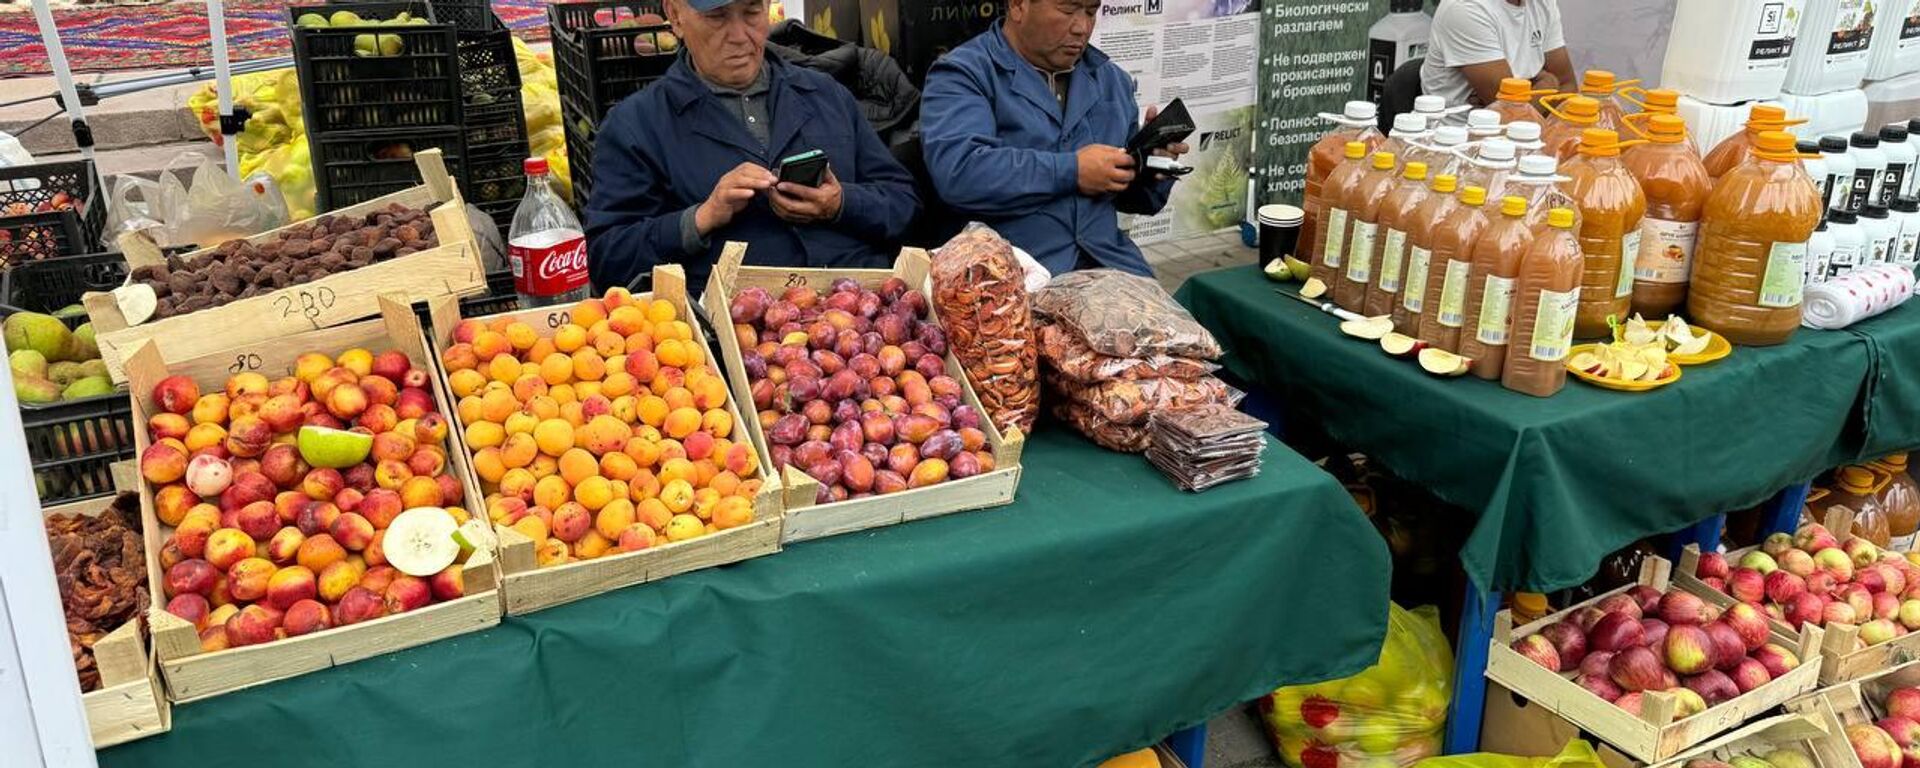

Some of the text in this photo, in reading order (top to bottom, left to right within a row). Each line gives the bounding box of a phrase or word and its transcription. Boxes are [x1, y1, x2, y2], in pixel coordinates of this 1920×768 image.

[1102, 4, 1142, 16] Реликт
[1275, 2, 1369, 18] Биологически
[1275, 20, 1344, 37] разлагаем
[1273, 50, 1366, 67] Не подвержен
[1272, 66, 1354, 85] прокисанию
[1271, 82, 1352, 99] и брожению
[1214, 127, 1241, 140] RELICT
[1268, 164, 1285, 177] Не
[540, 240, 587, 278] Coca-Co
